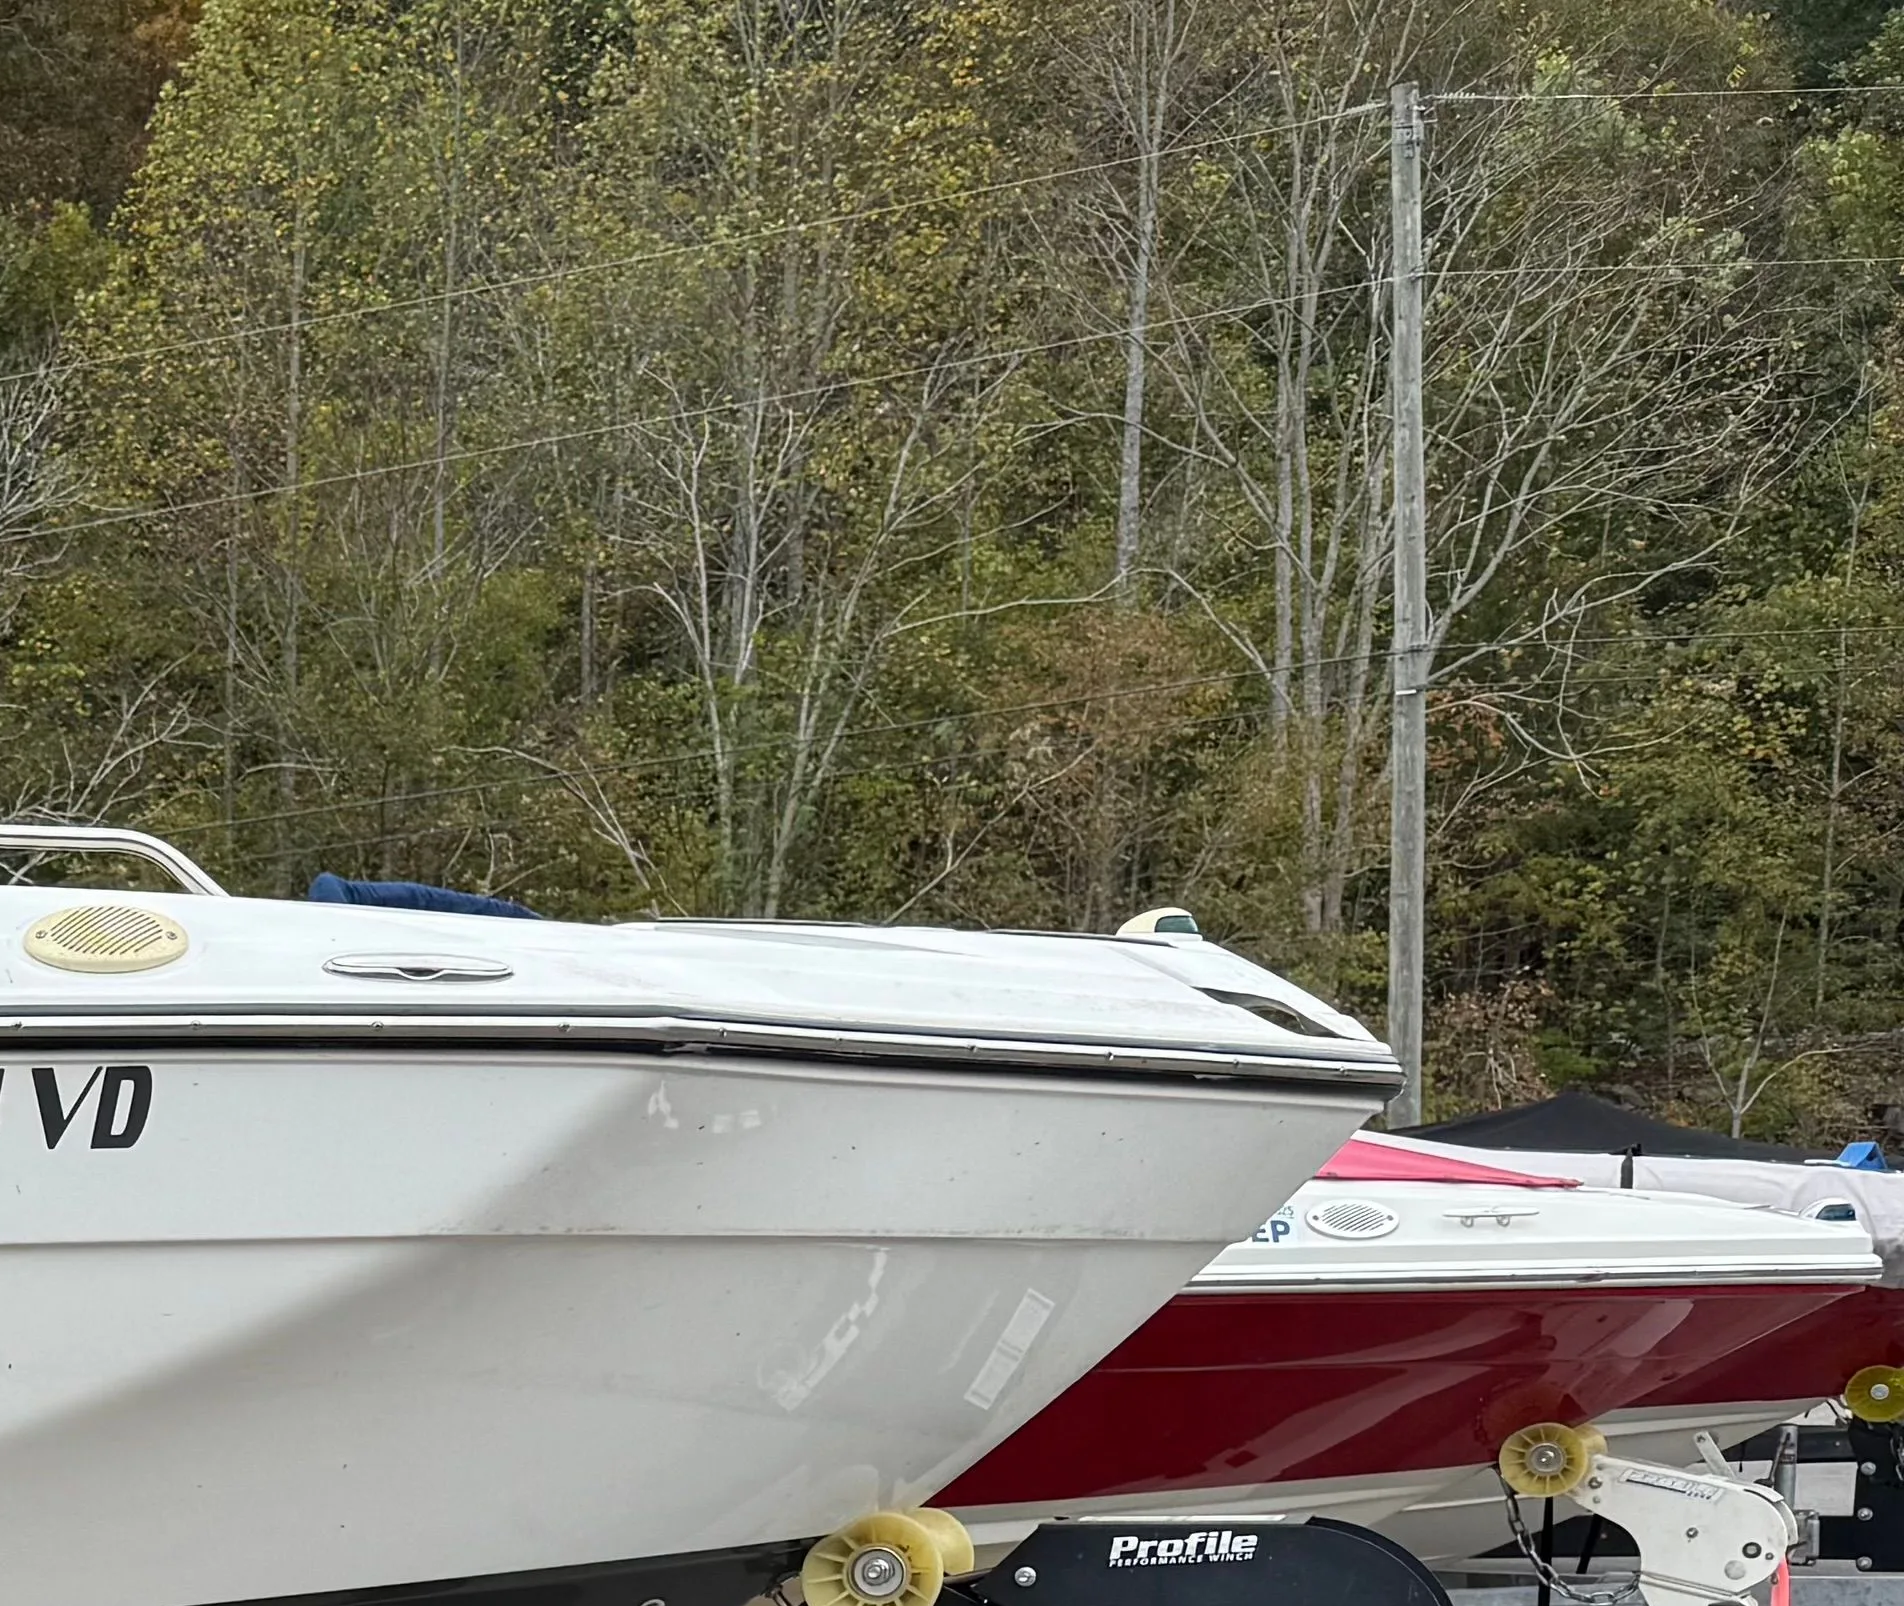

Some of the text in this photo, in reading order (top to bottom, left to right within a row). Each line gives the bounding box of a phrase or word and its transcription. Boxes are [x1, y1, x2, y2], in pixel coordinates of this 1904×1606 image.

[31, 1065, 153, 1151] VD
[1252, 1220, 1290, 1243] EP
[1109, 1530, 1258, 1560] Profile
[1109, 1551, 1254, 1568] PERFORMANCE WINCH
